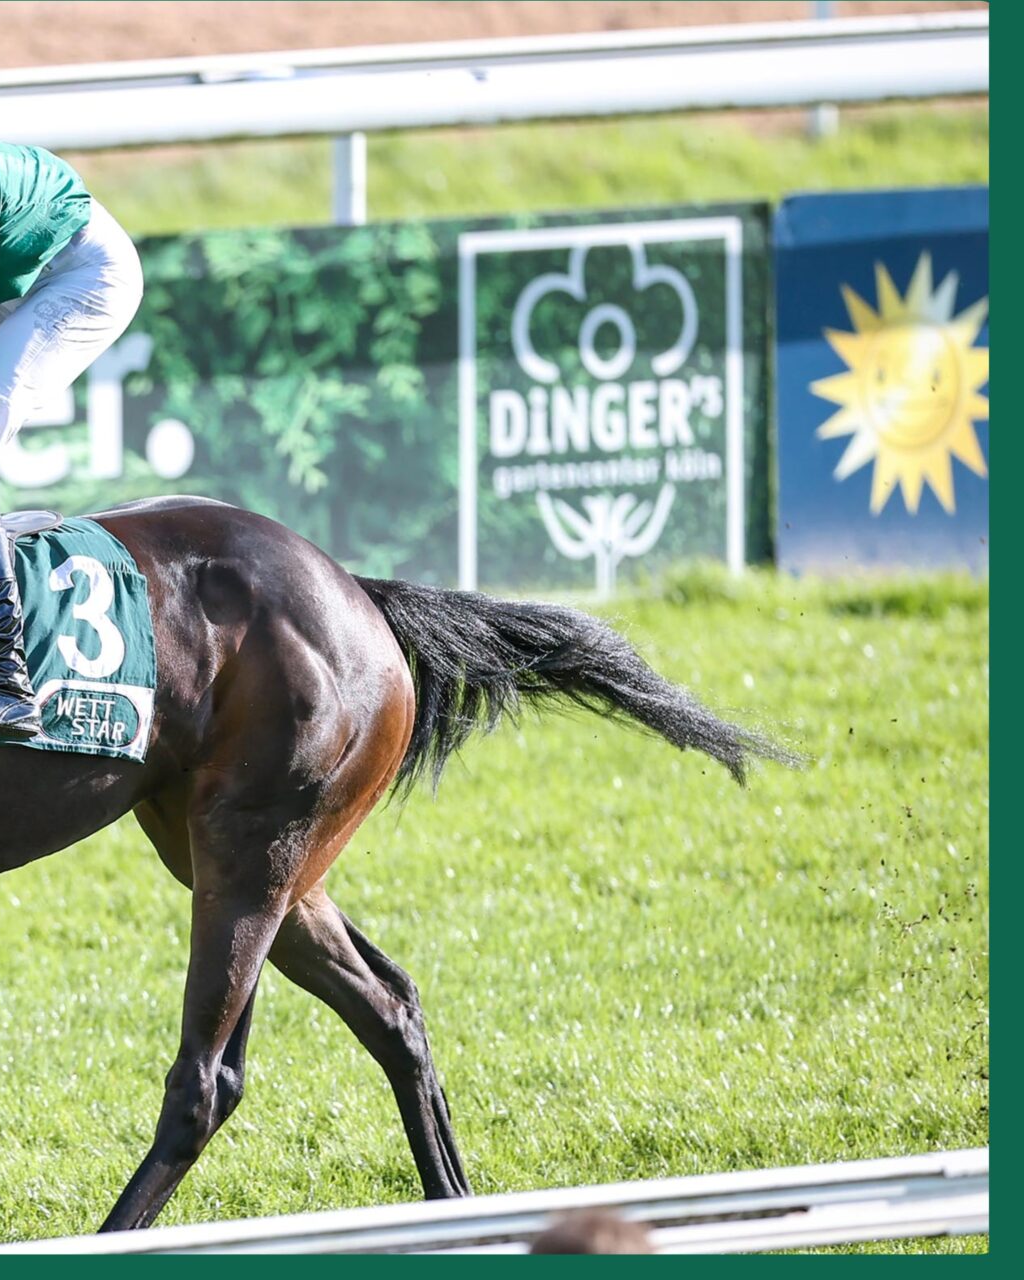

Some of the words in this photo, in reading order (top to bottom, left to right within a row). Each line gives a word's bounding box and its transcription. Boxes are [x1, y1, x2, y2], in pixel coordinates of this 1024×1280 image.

[49, 555, 126, 679] 3
[56, 694, 116, 721] WETT
[71, 718, 126, 741] STAR
